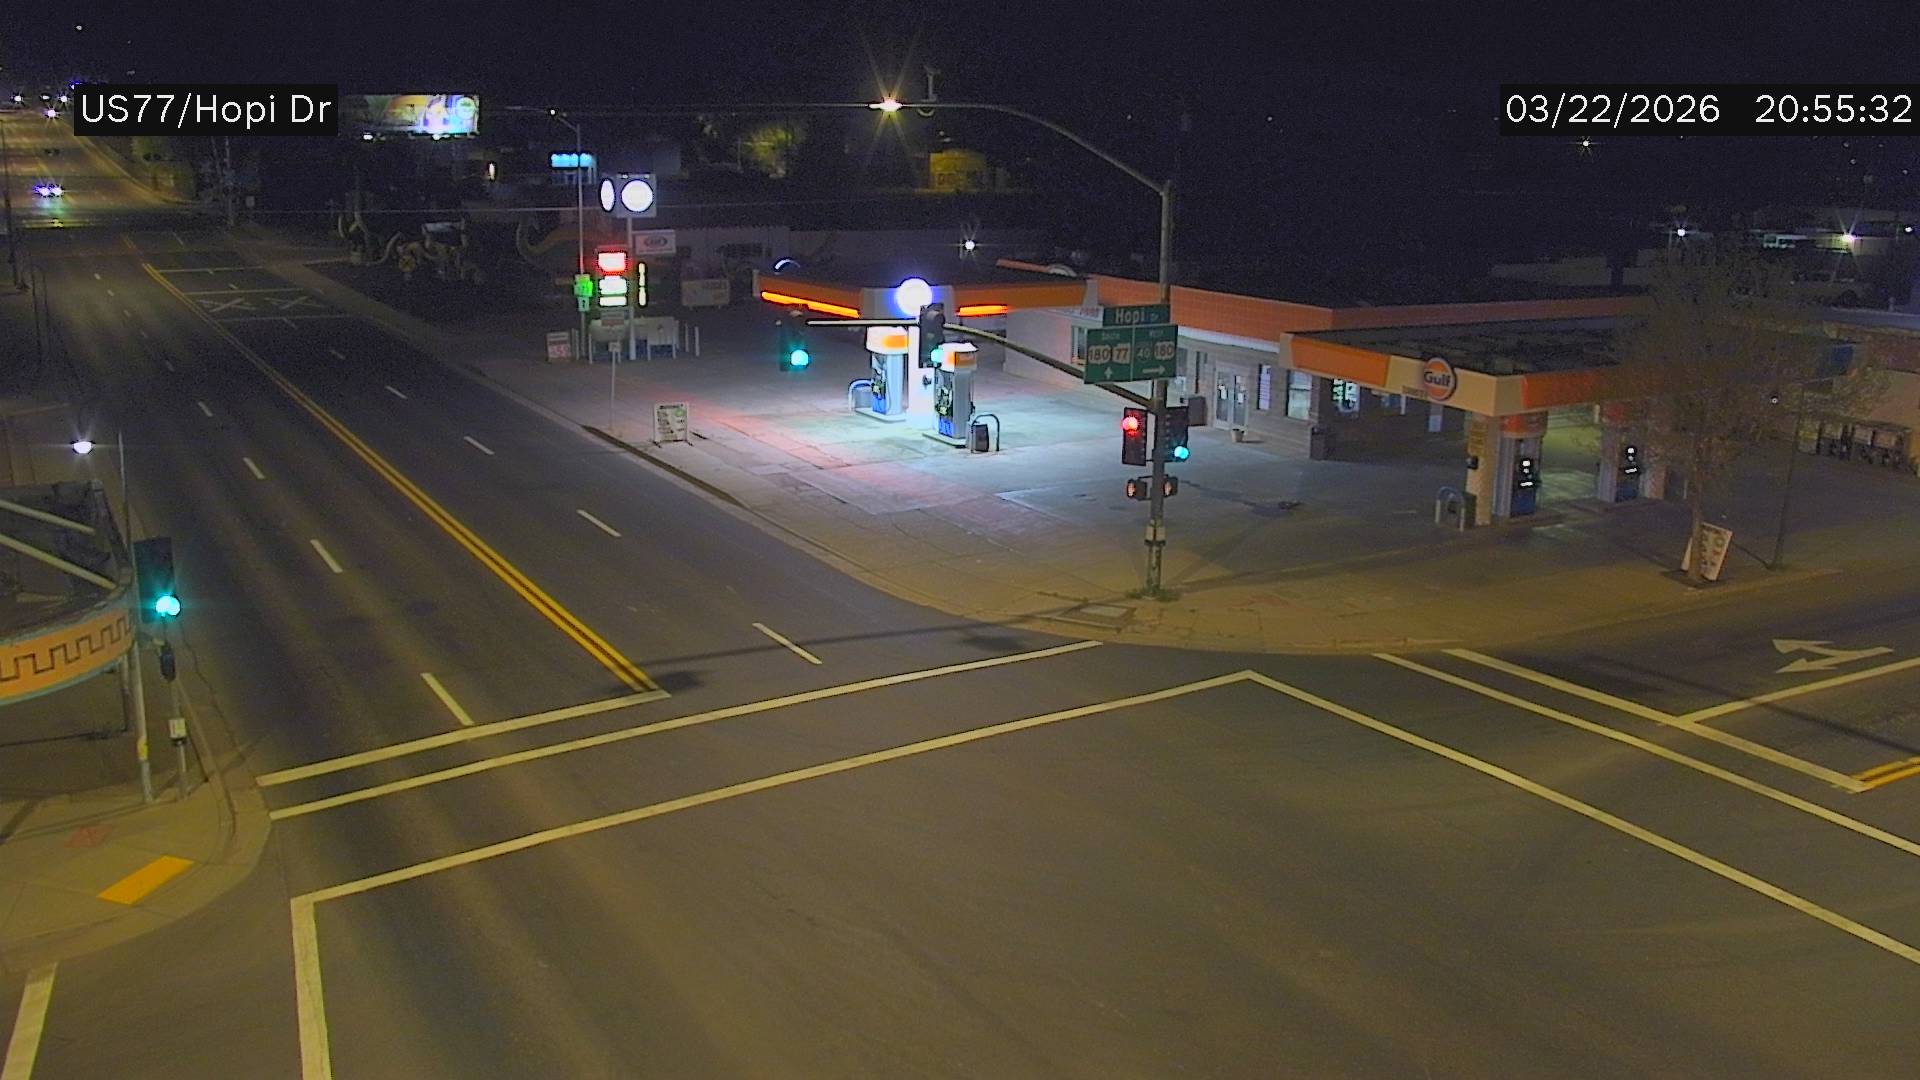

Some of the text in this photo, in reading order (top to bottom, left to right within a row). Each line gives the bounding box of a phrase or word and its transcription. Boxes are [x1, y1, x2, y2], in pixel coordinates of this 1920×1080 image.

[1115, 308, 1144, 324] Hopi
[1088, 347, 1129, 359] 180 77
[1137, 343, 1174, 359] 40 180
[1424, 370, 1451, 387] Gulf
